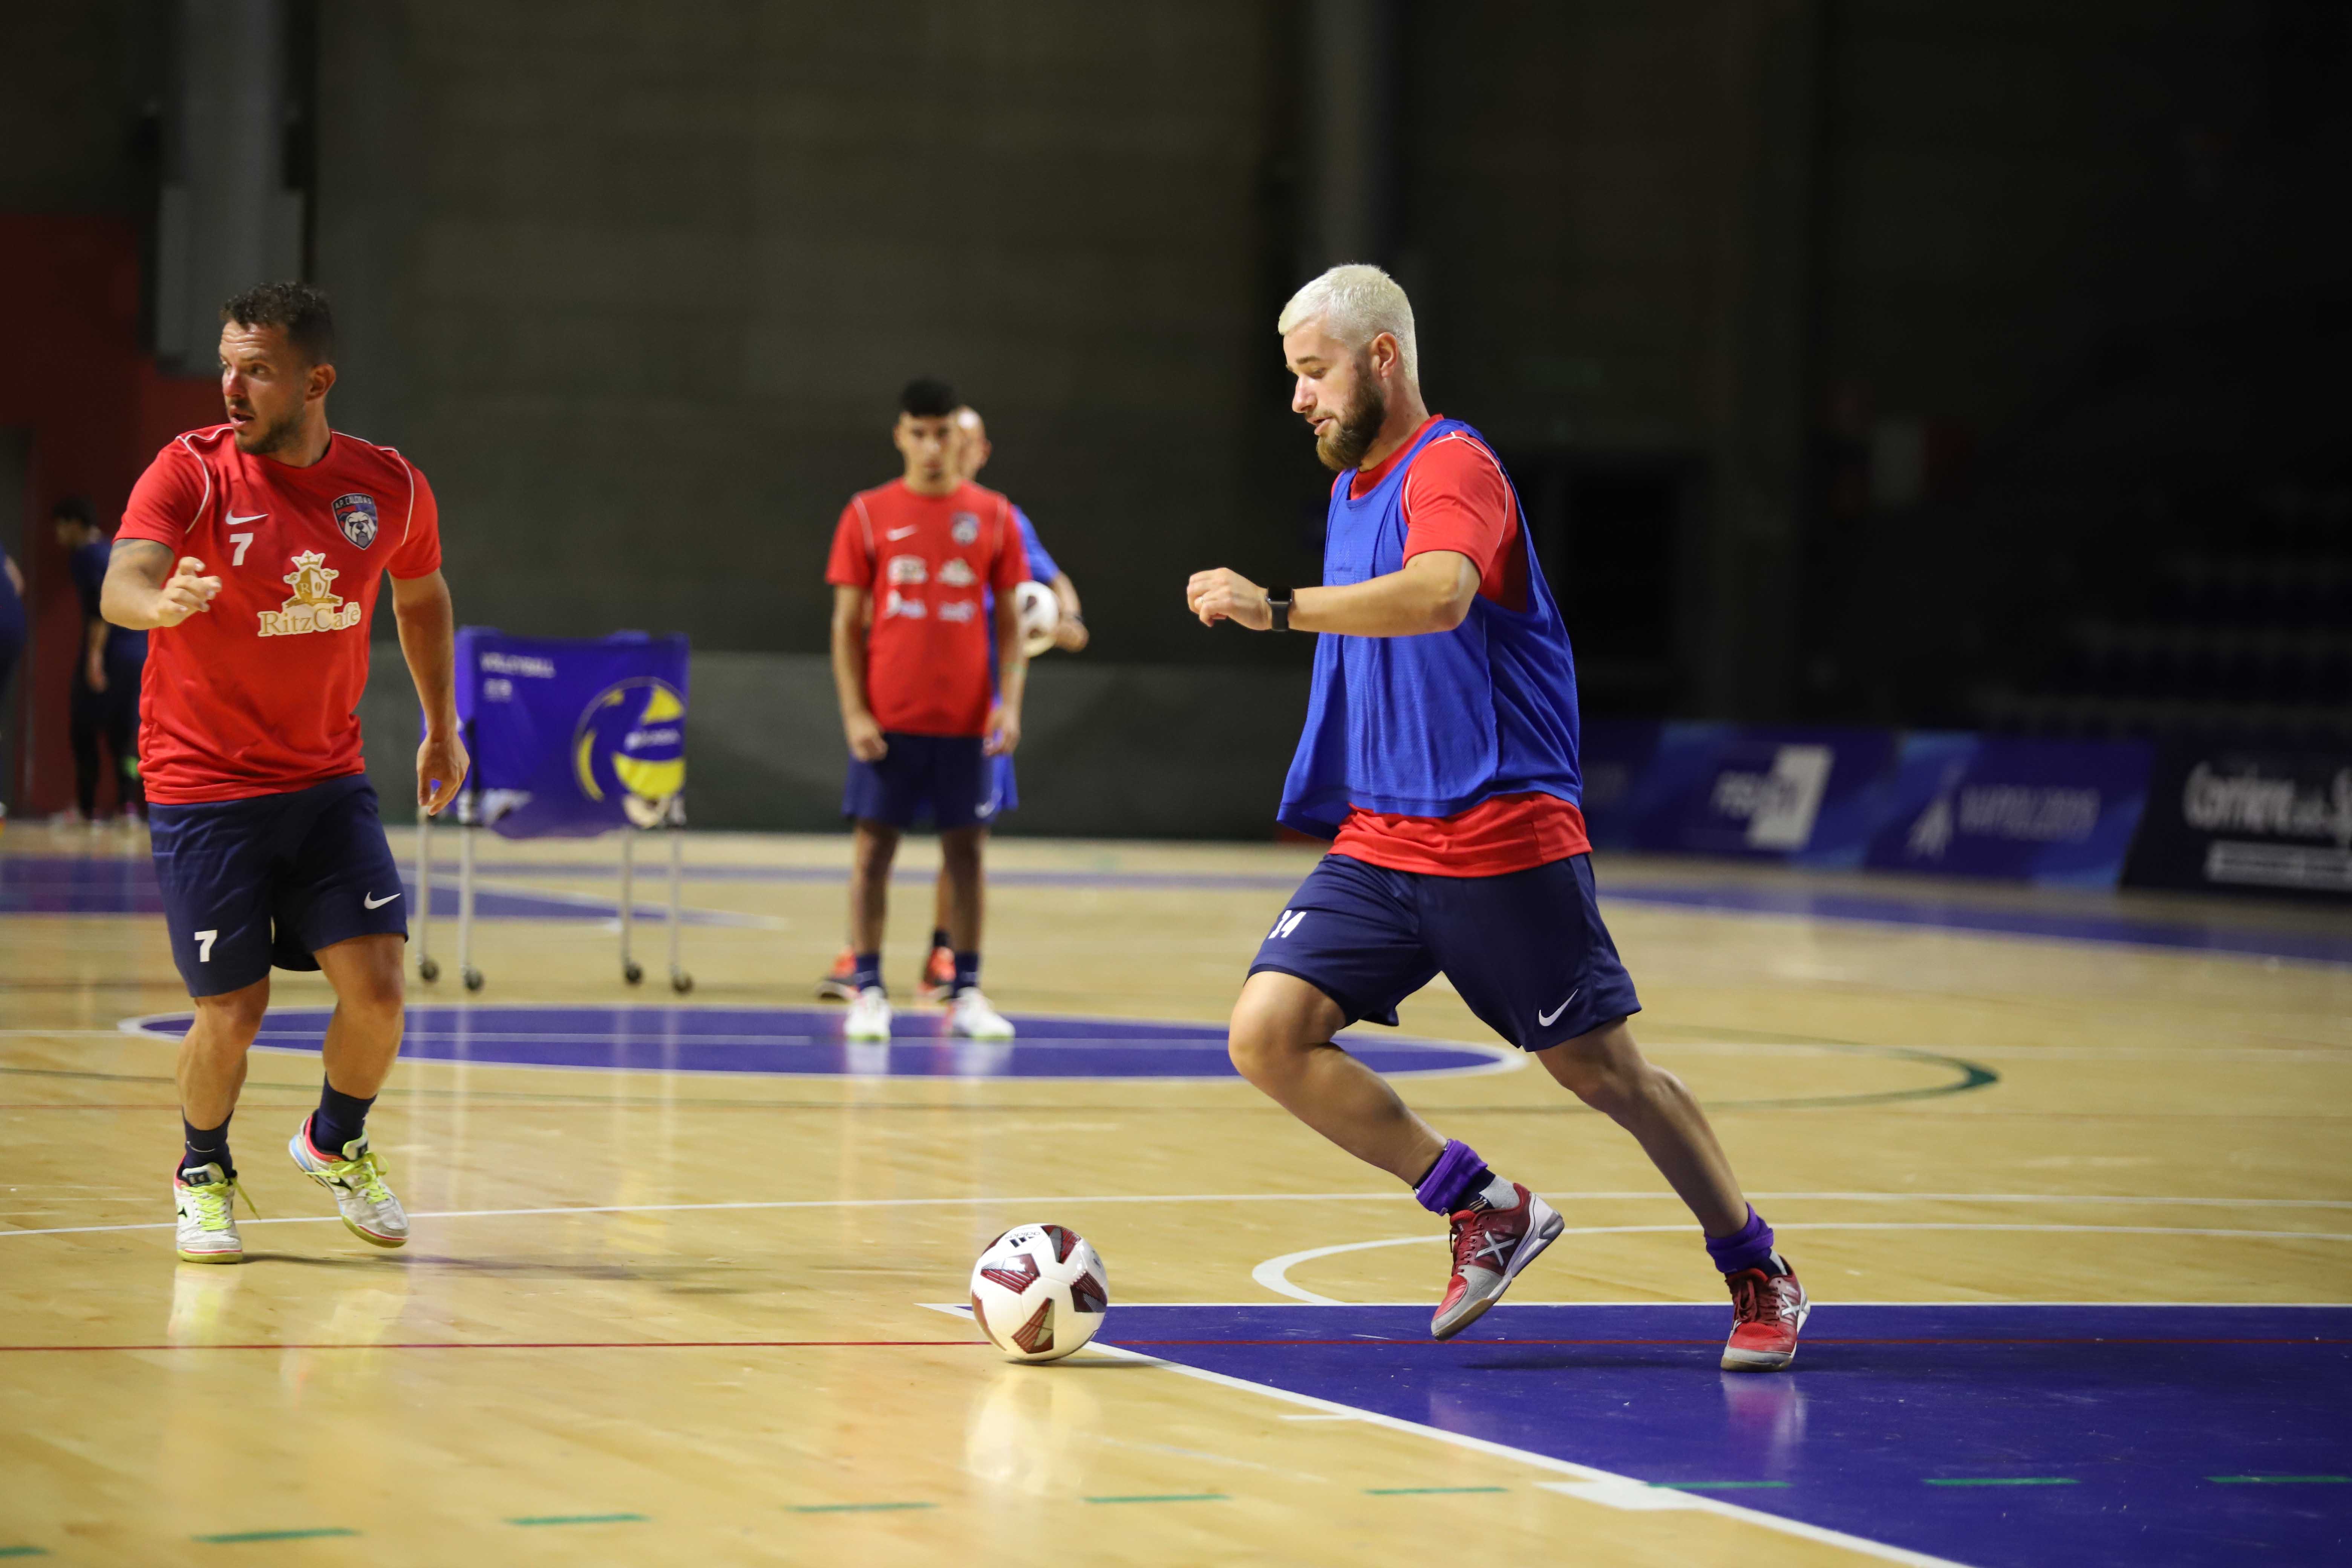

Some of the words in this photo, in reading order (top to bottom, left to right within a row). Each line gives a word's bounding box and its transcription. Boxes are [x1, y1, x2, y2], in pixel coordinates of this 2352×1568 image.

[229, 532, 254, 566] 7
[1268, 910, 1307, 939] 14
[194, 929, 217, 962] 7
